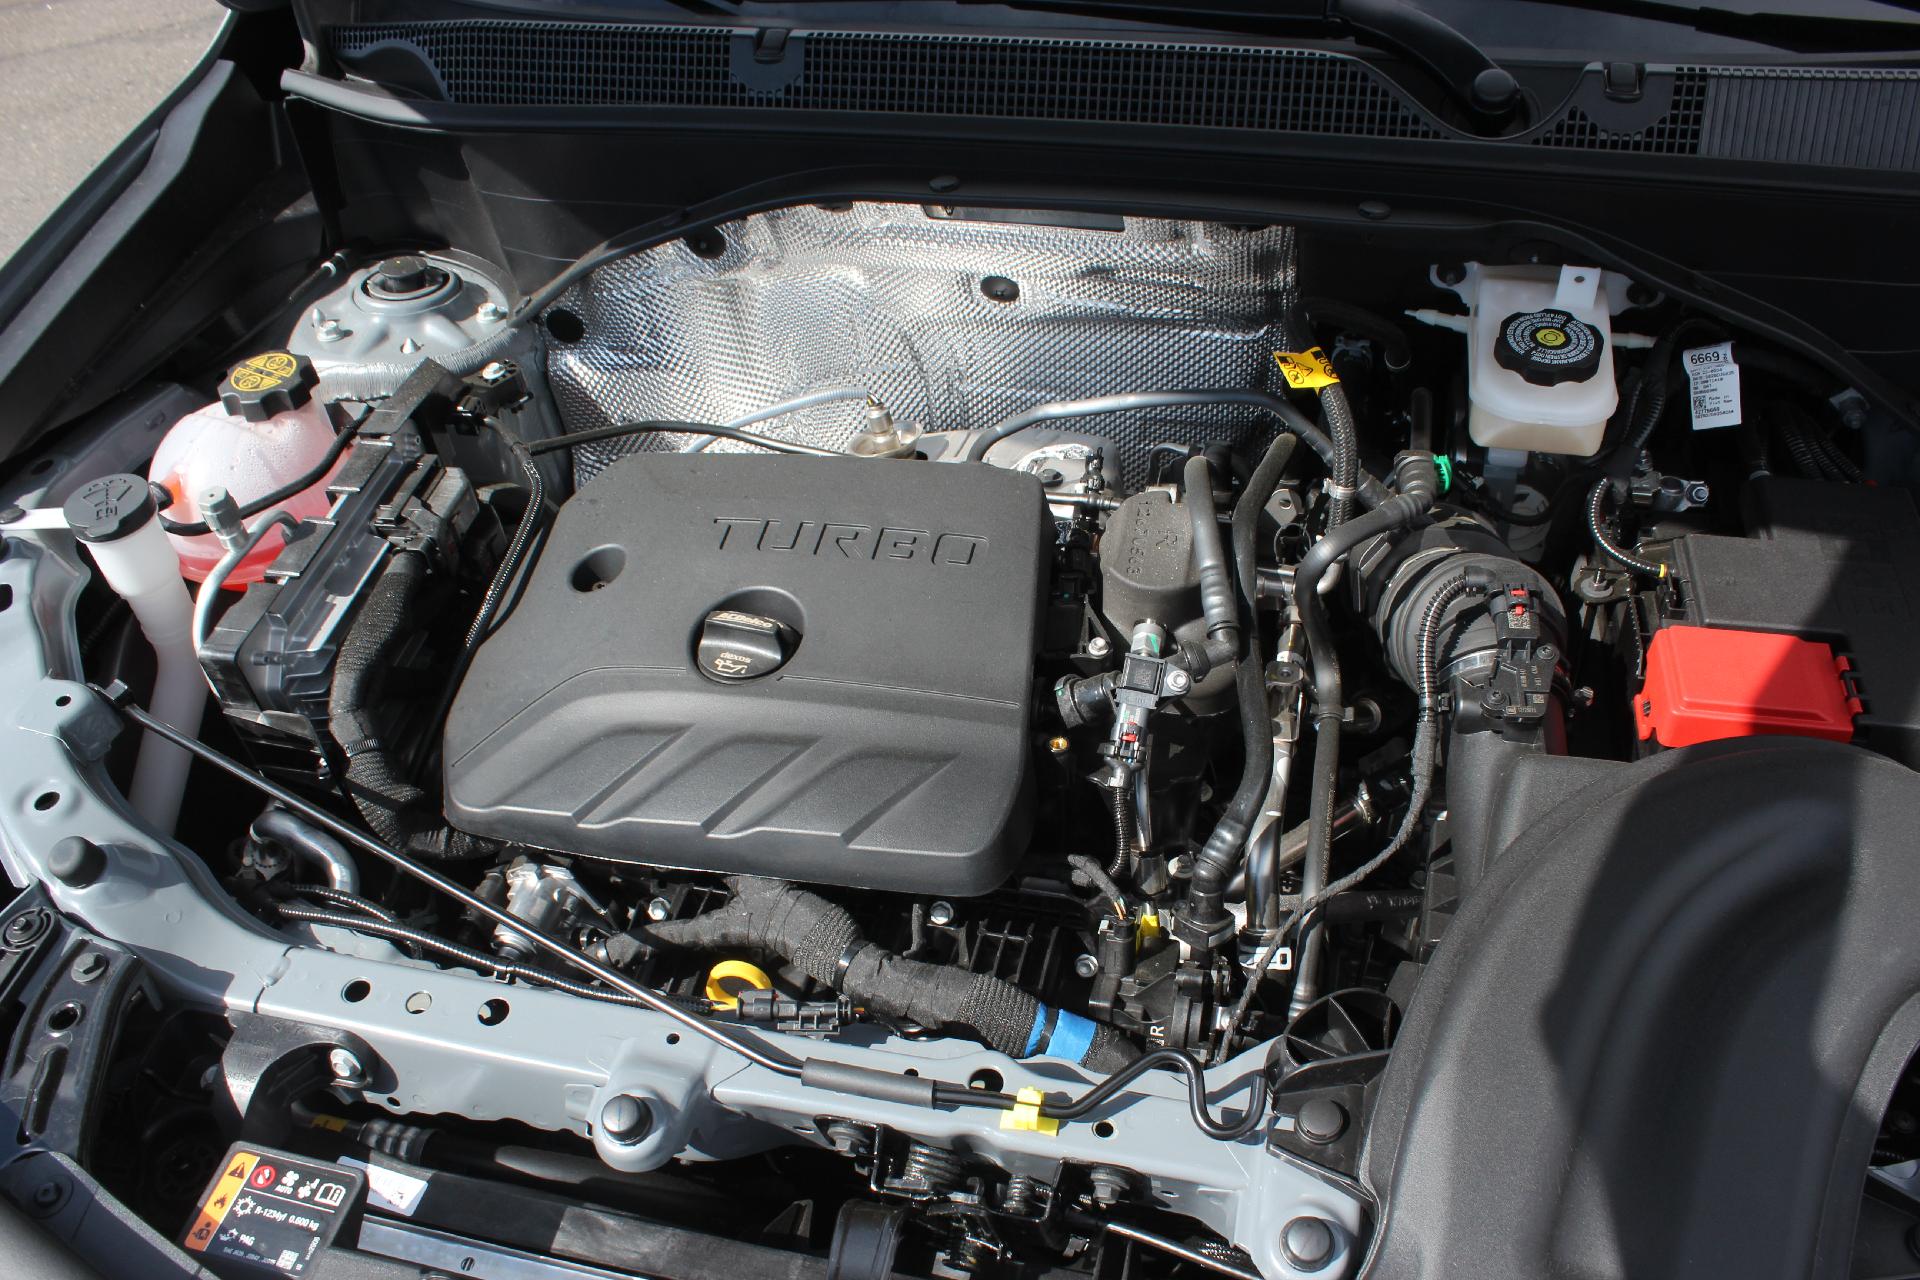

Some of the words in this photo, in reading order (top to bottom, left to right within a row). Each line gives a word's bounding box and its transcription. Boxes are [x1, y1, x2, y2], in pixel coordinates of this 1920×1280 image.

[1690, 351, 1720, 365] 6669
[713, 517, 990, 566] TURBO
[715, 612, 773, 628] ACDelco
[720, 652, 753, 663] dexos
[274, 1185, 293, 1195] AUTO
[308, 1220, 320, 1231] kg
[239, 1234, 255, 1247] PAG
